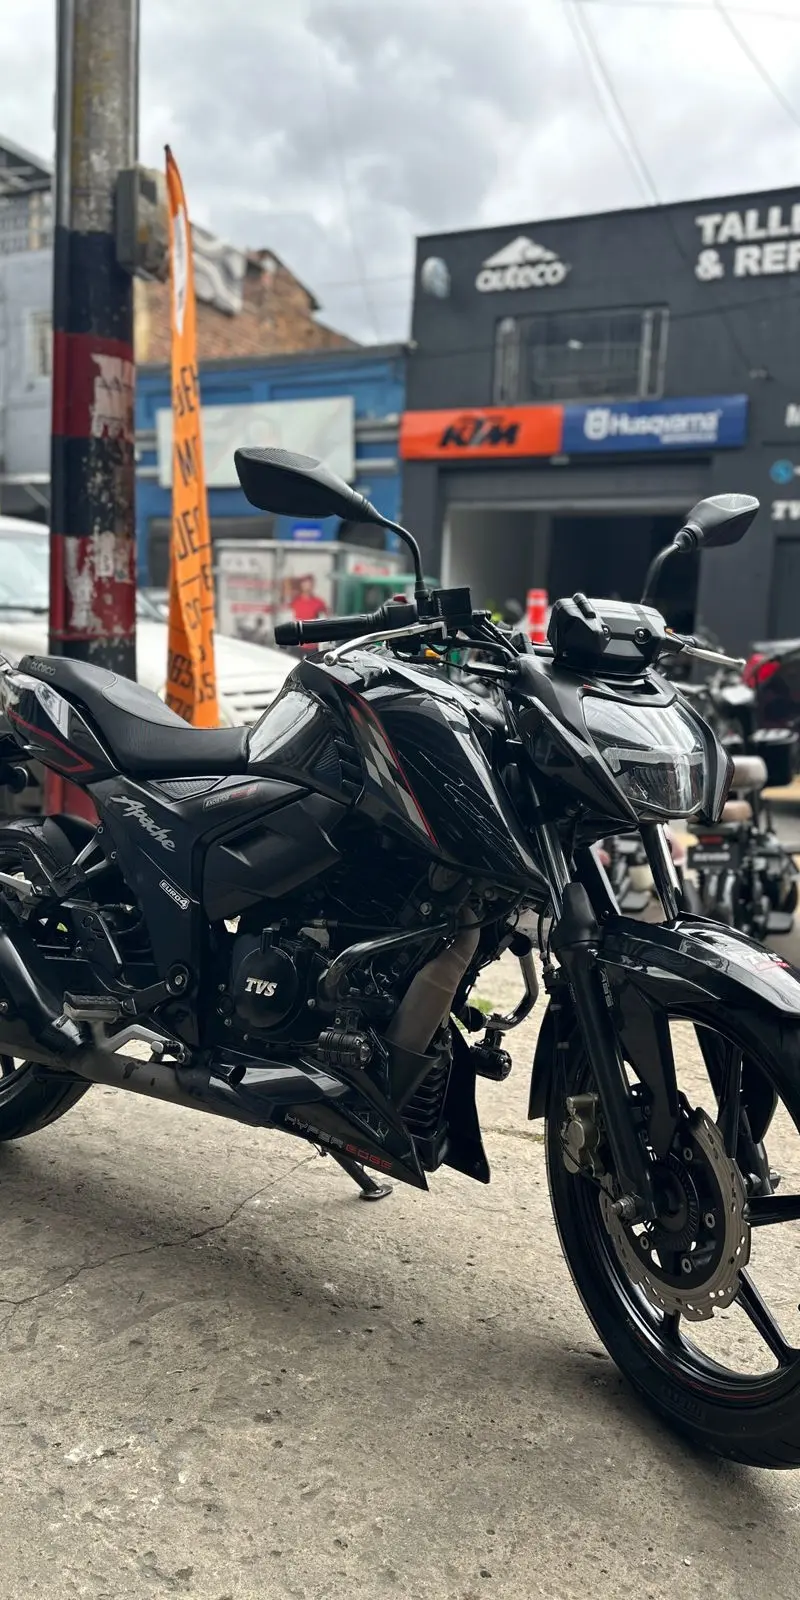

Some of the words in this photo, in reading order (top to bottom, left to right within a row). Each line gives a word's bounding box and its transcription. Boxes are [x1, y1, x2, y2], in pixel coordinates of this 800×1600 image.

[475, 261, 568, 292] auteco
[438, 416, 522, 448] KTM
[610, 411, 719, 437] Husqvarna
[30, 661, 56, 676] auteco
[110, 795, 177, 853] Apache
[244, 976, 278, 997] TVS
